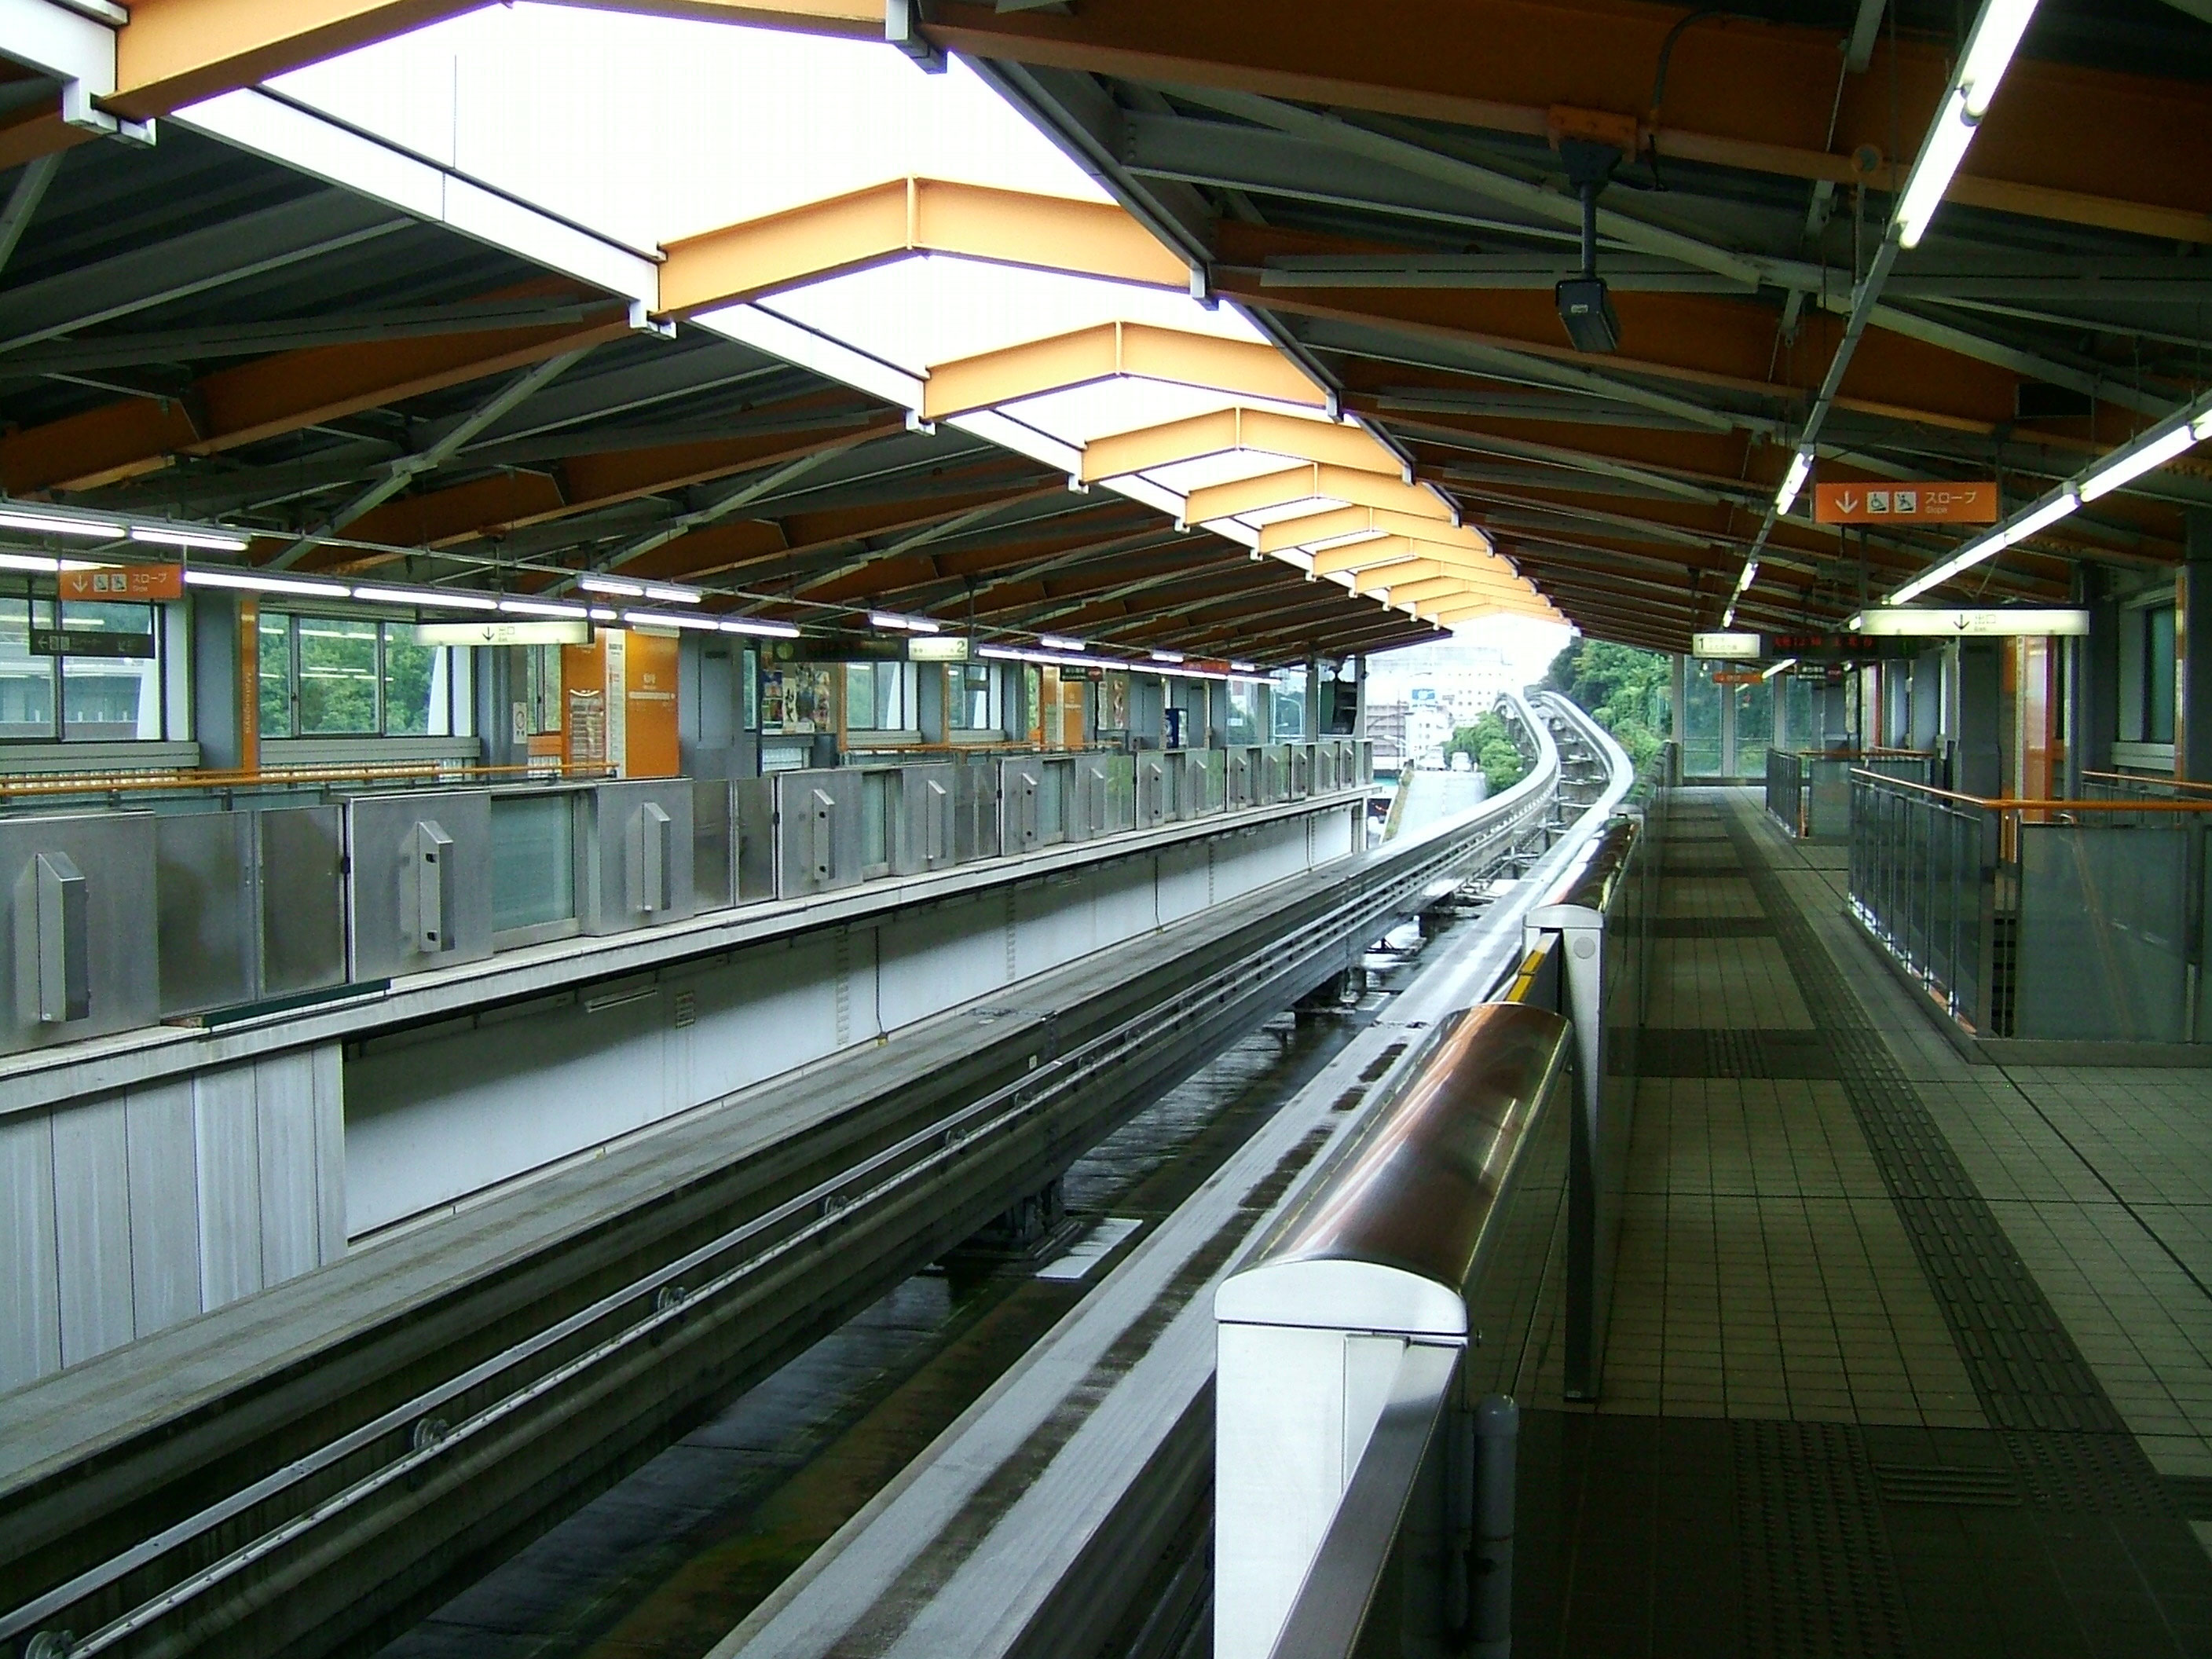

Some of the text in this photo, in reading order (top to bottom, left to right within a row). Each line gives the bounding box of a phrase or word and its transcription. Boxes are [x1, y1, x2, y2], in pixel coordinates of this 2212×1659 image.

[1925, 491, 1976, 504] スロープ
[957, 640, 965, 654] 2
[1698, 638, 1704, 650] 1
